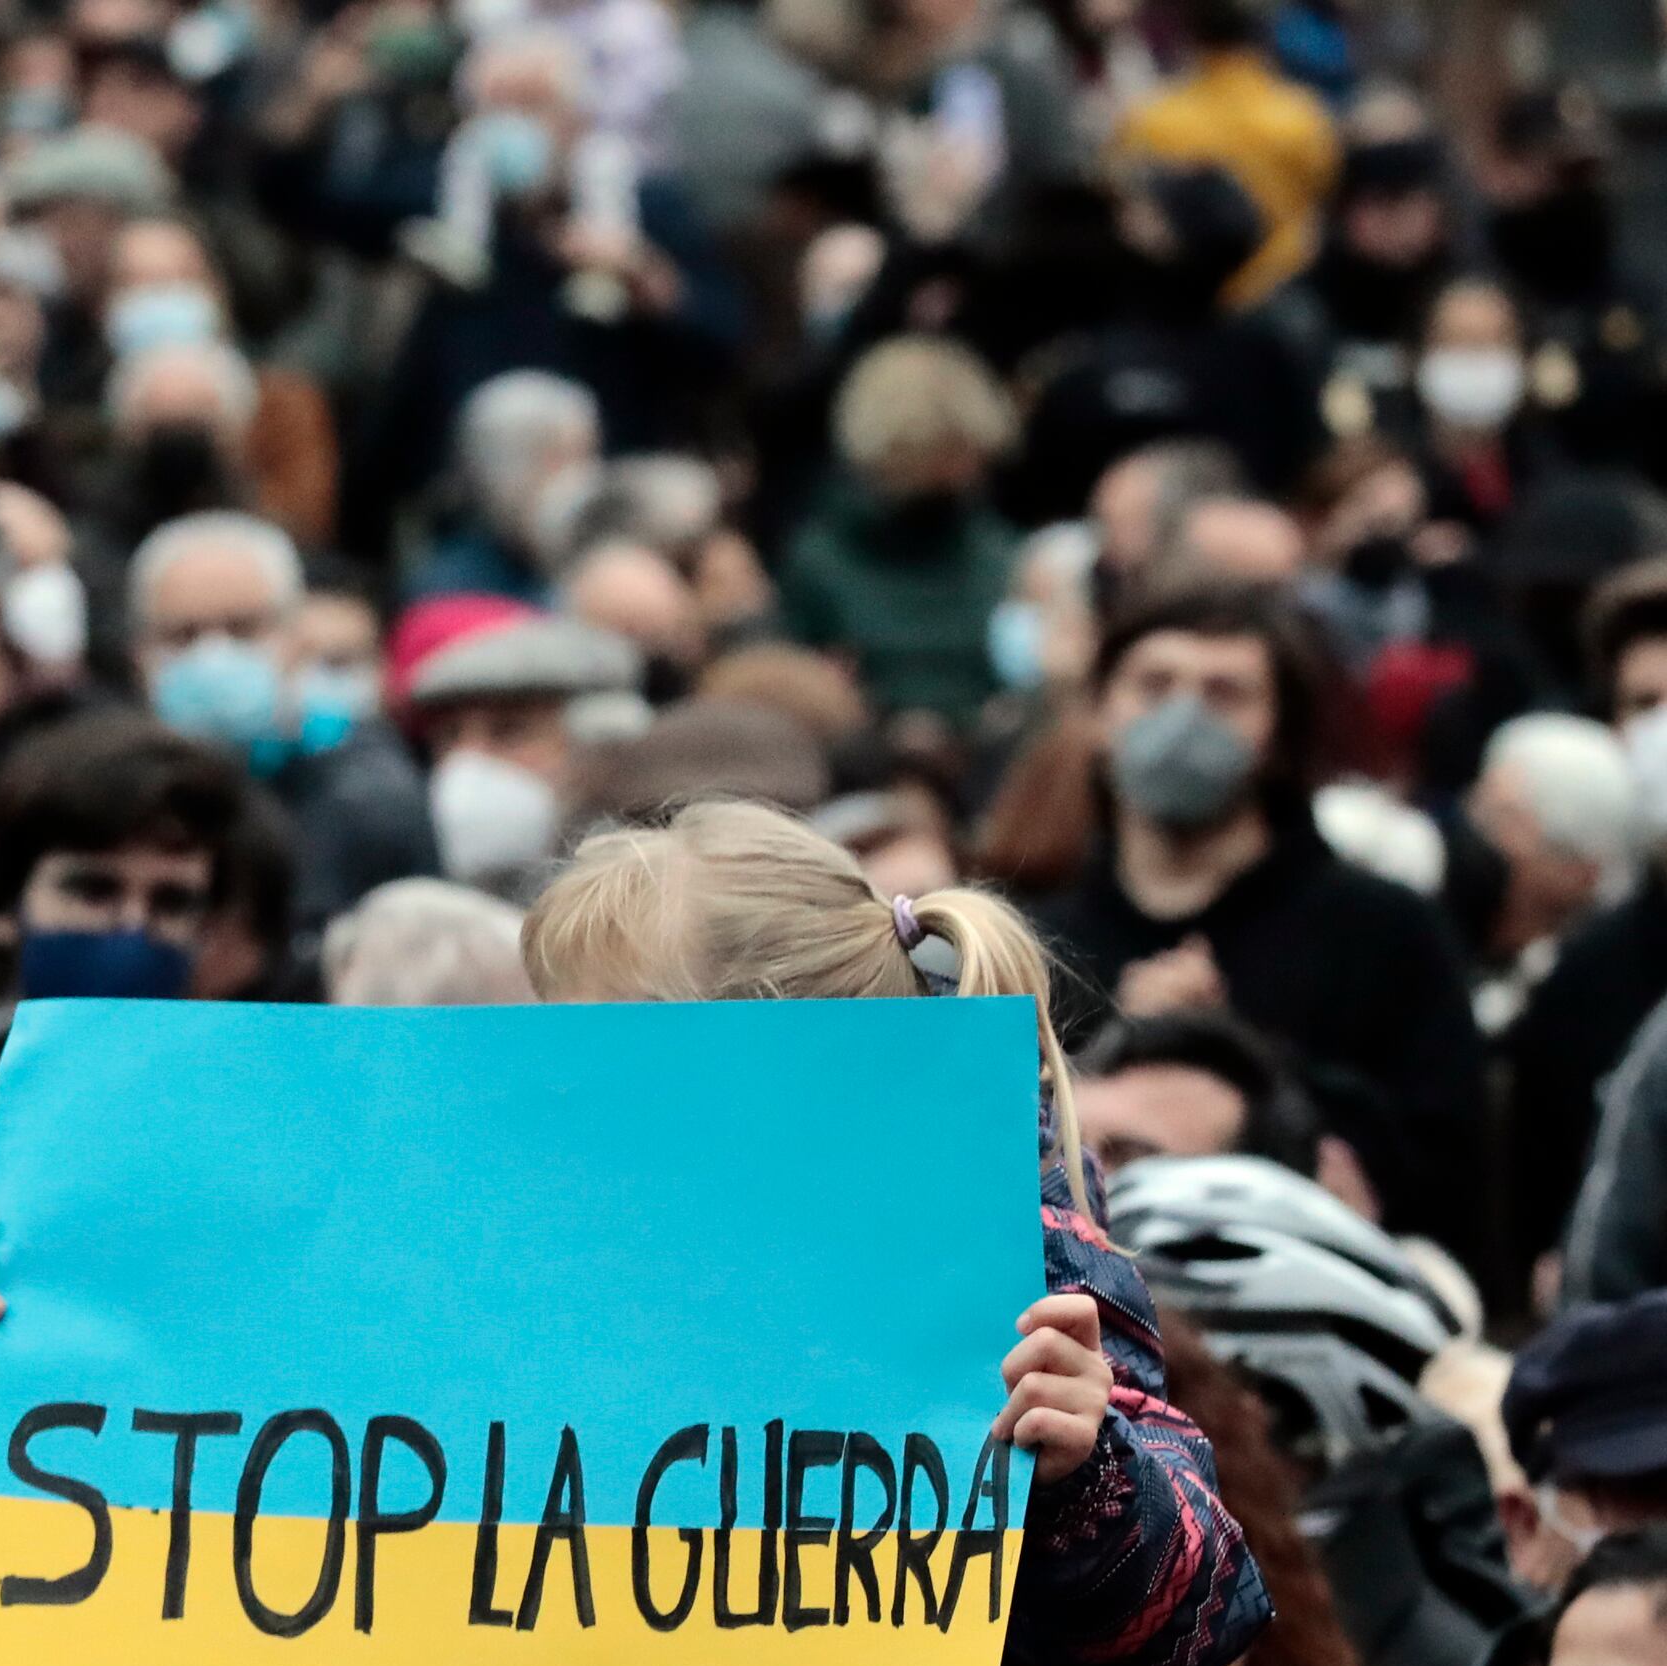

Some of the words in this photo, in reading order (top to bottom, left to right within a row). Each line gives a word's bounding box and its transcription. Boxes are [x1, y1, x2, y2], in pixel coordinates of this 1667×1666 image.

[0, 1400, 446, 1638] STOP
[468, 1419, 597, 1631] LA
[631, 1417, 1012, 1633] GUERRA
